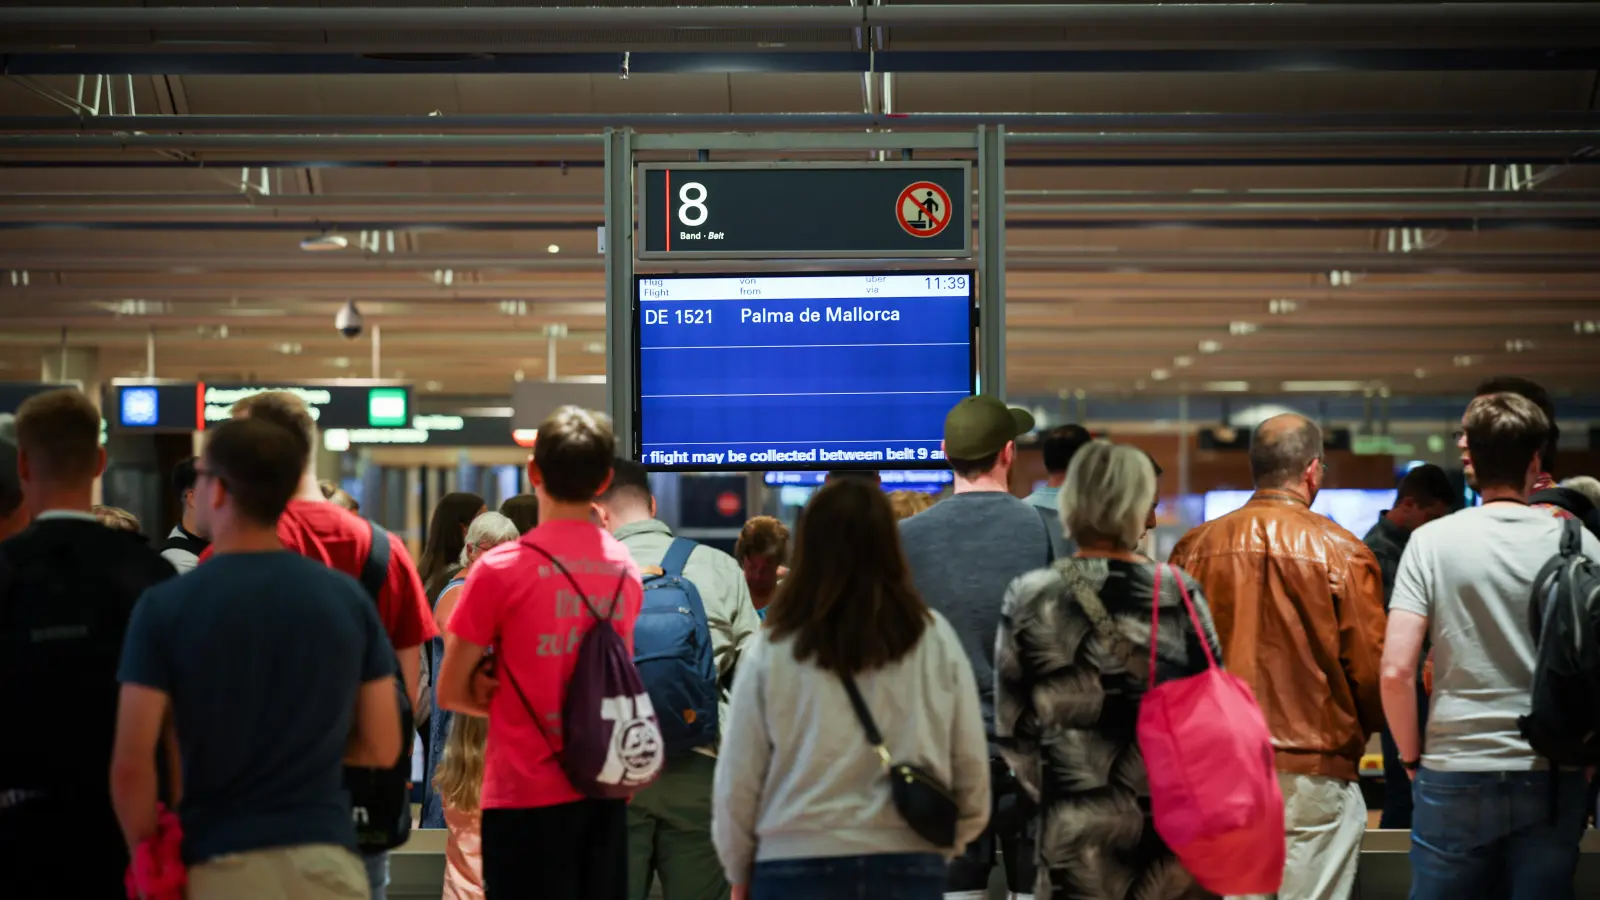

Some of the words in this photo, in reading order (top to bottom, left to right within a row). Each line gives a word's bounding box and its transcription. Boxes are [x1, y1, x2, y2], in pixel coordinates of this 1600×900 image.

[678, 181, 709, 227] 8
[680, 231, 702, 240] Band
[707, 231, 725, 240] Belt
[644, 278, 663, 288] Flug
[865, 284, 879, 294] via
[924, 276, 966, 290] 11:39
[644, 288, 670, 299] Flight
[739, 287, 762, 296] from
[645, 309, 669, 325] DE
[675, 309, 713, 324] 1521
[740, 307, 794, 323] Palma
[799, 307, 821, 323] de
[825, 306, 901, 322] Mallorca
[649, 450, 689, 465] flight
[692, 452, 725, 465] may
[727, 449, 747, 463] be
[750, 448, 816, 463] collected
[819, 448, 883, 461] between
[886, 447, 916, 460] belt
[917, 447, 928, 460] 9
